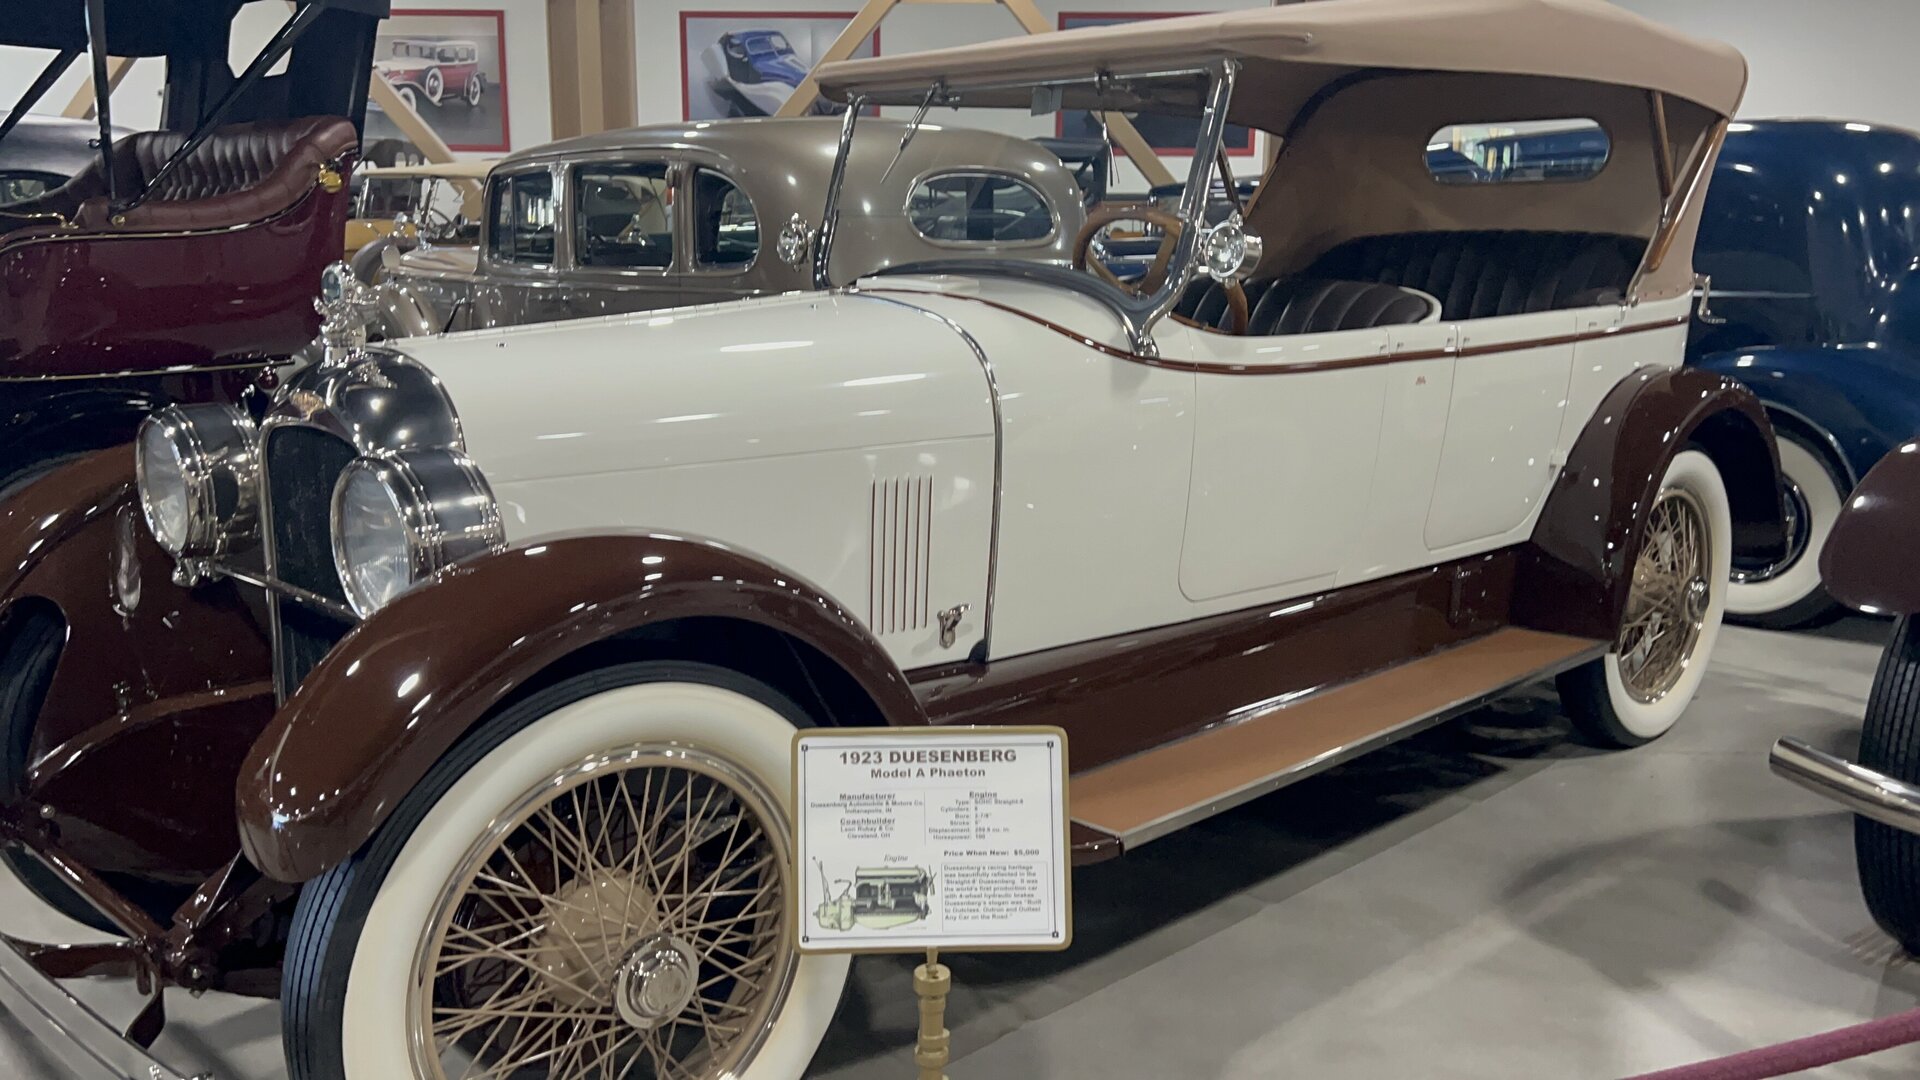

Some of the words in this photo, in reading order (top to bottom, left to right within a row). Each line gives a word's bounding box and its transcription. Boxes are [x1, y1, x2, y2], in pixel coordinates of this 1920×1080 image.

[839, 751, 883, 765] 1923
[889, 749, 1017, 764] DUESENBERG
[870, 768, 912, 779] Model
[915, 767, 926, 778] A
[929, 767, 986, 778] Phaeton
[839, 793, 896, 801] Manufacturer
[969, 791, 998, 800] Engine
[840, 817, 896, 826] Coachbuilder
[943, 849, 964, 857] Price
[1013, 848, 1040, 857] $5,000
[883, 853, 909, 863] Engine
